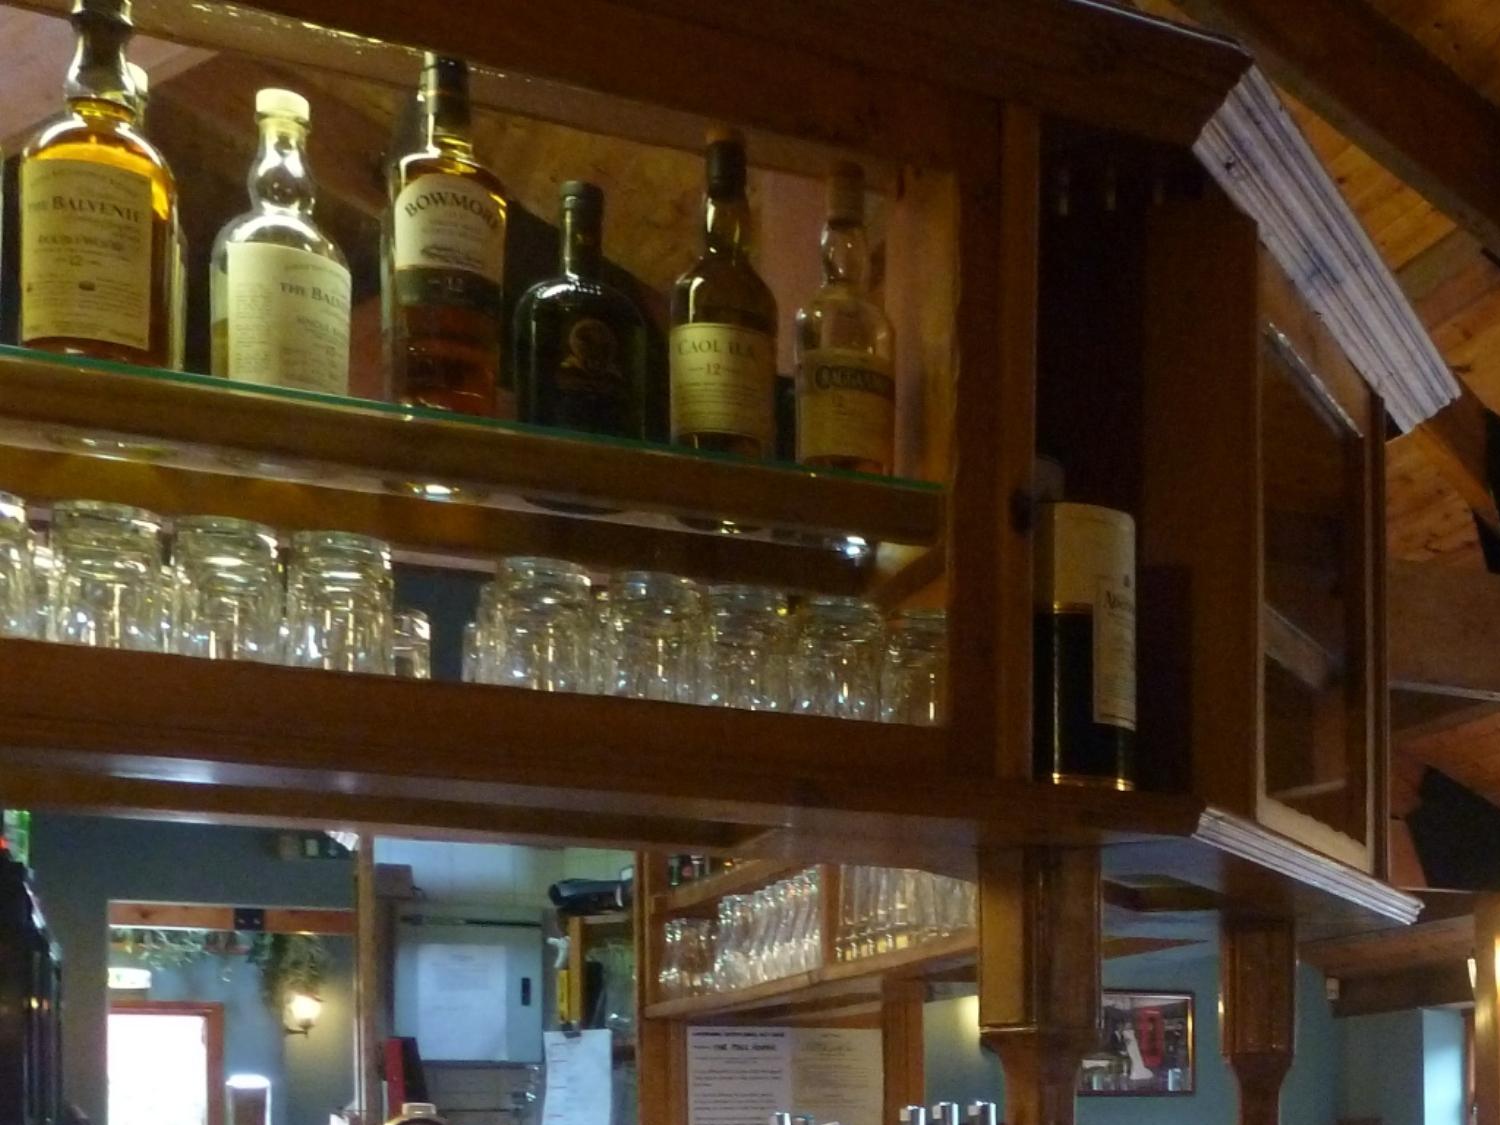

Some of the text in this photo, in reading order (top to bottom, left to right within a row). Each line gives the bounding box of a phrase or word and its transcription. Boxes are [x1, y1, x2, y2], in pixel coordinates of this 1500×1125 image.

[52, 195, 144, 223] BALVENIE
[678, 338, 720, 356] CAOL
[705, 363, 722, 376] 12
